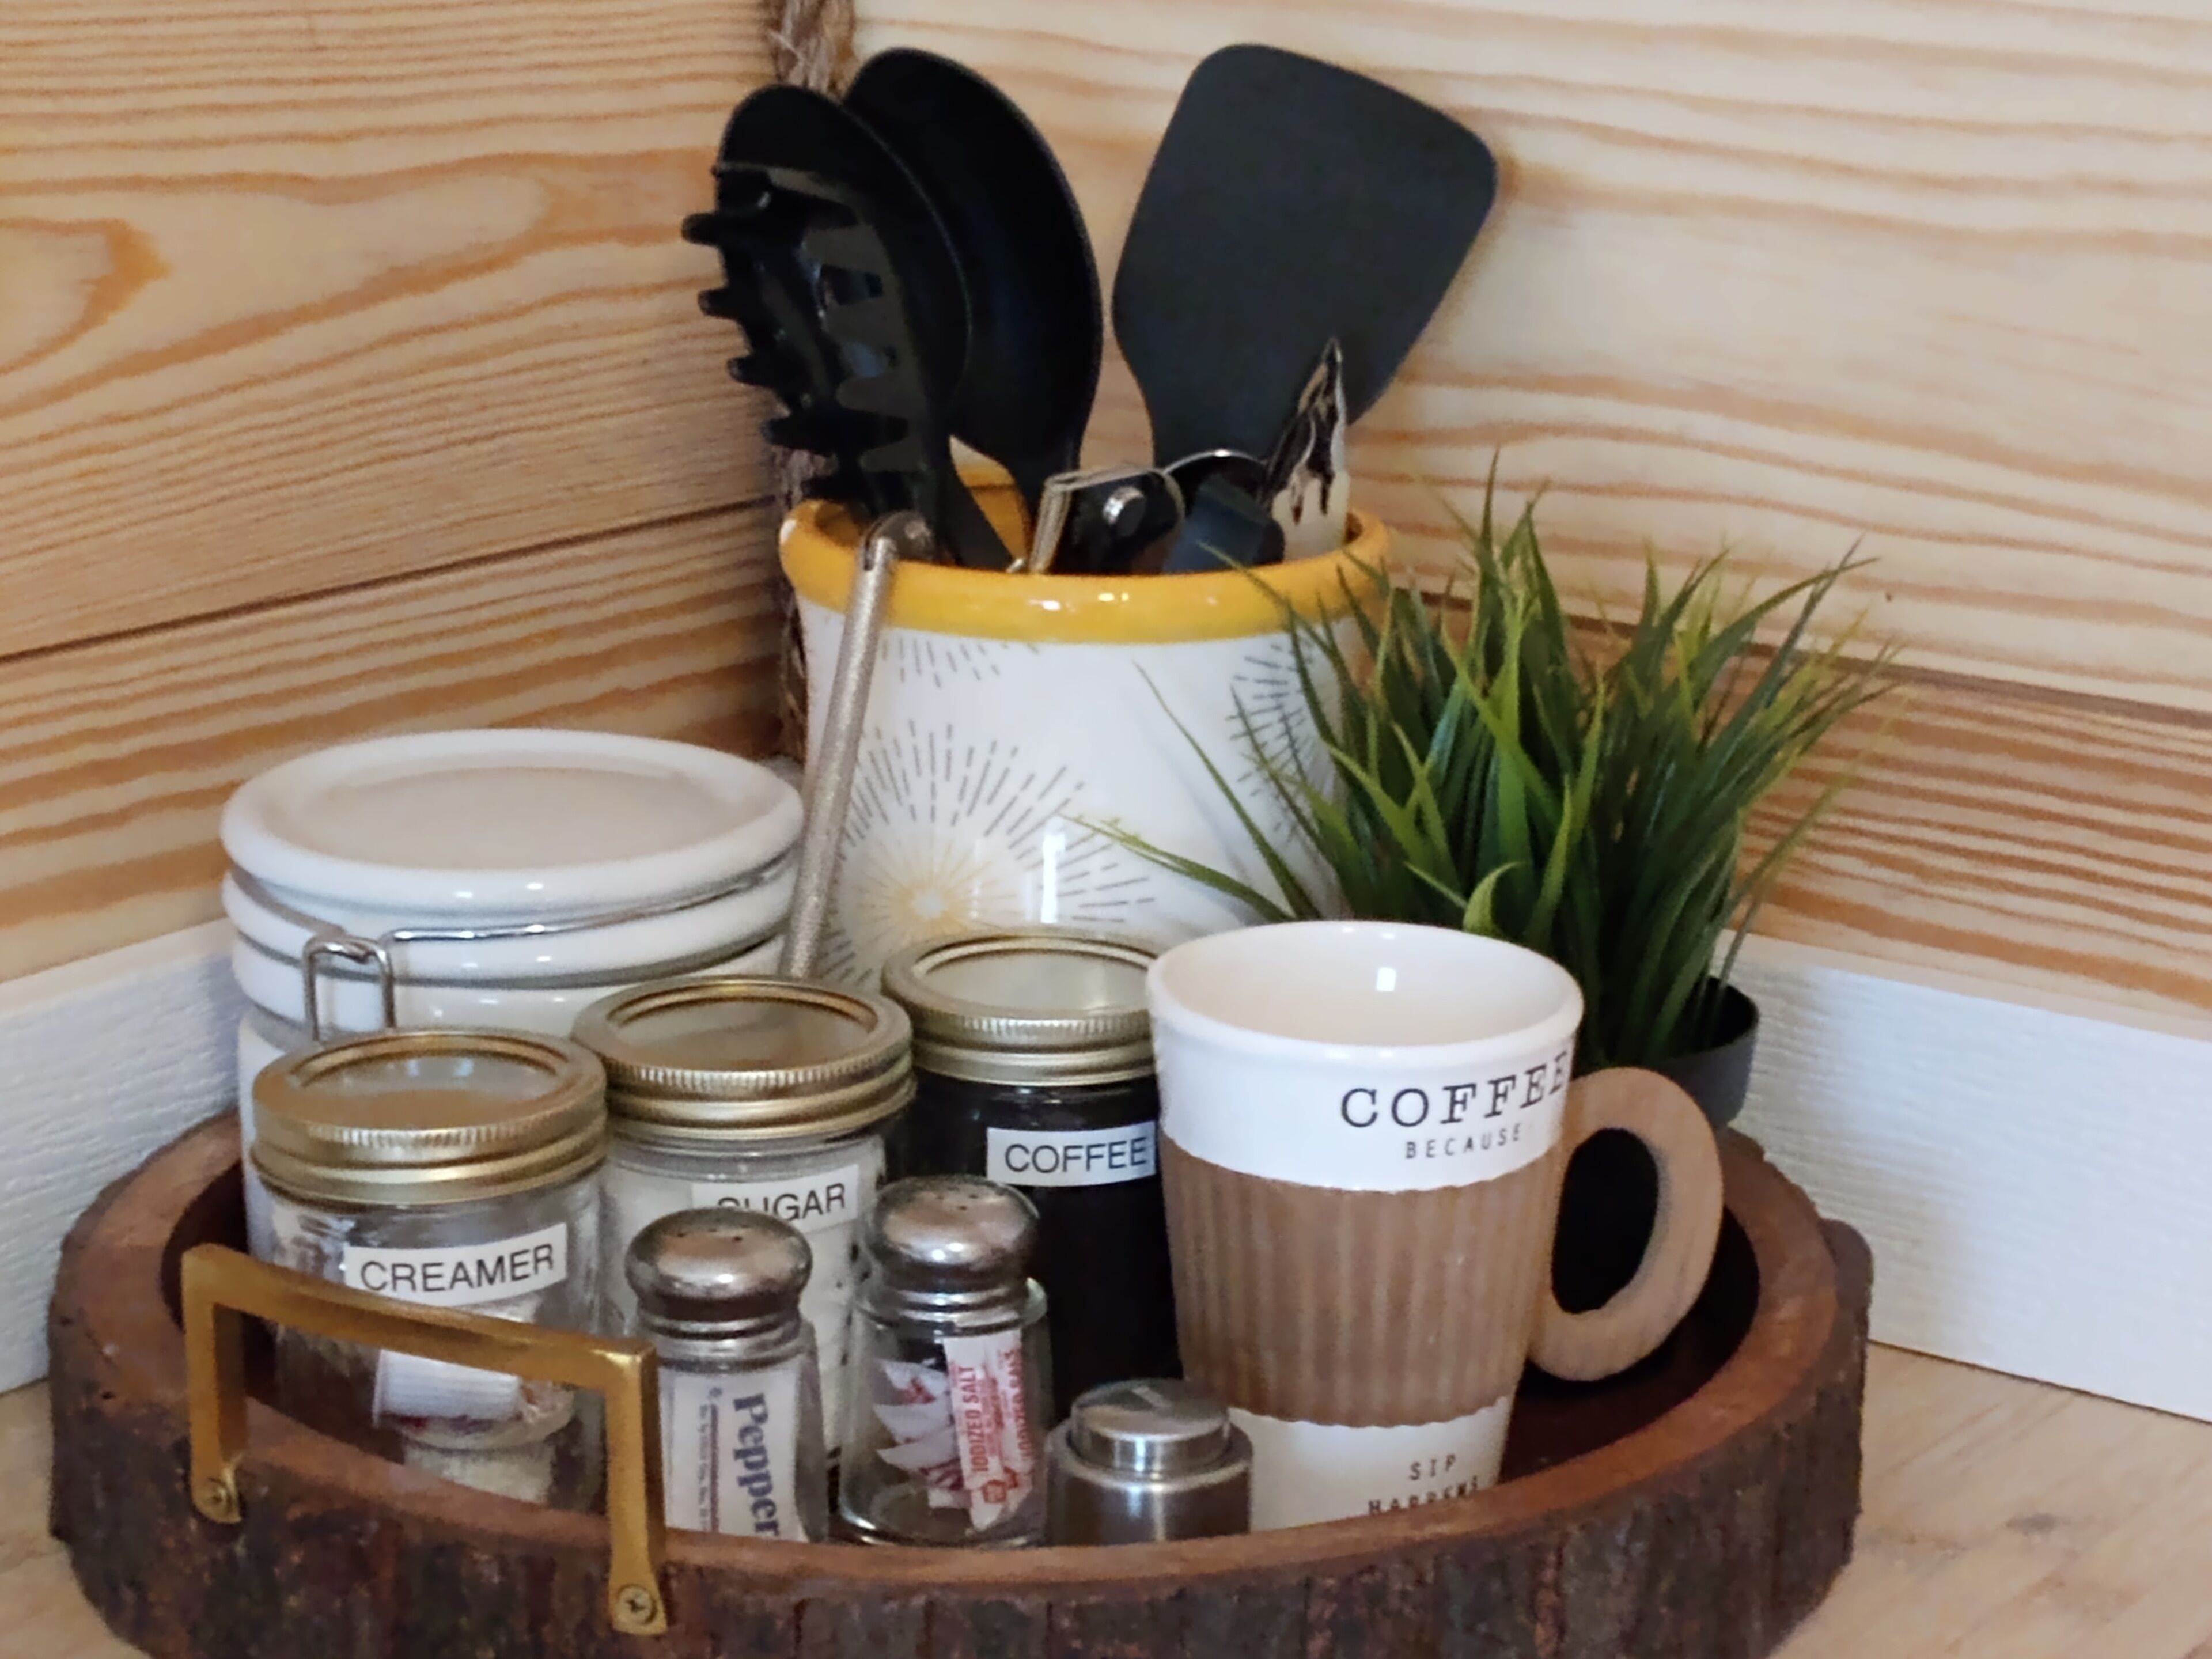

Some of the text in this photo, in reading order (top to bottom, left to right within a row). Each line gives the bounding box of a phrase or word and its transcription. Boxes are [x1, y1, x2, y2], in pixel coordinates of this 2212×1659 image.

[1341, 1050, 1567, 1128] COFFEE
[1005, 1137, 1147, 1173] COFFEE
[1406, 1123, 1521, 1159] BECAUSE
[718, 1183, 846, 1222] GAR
[361, 1243, 554, 1292] CREAMER
[958, 1366, 989, 1472] IODIZED SALT
[733, 1393, 781, 1536] Pepper
[1409, 1453, 1457, 1481] SIP
